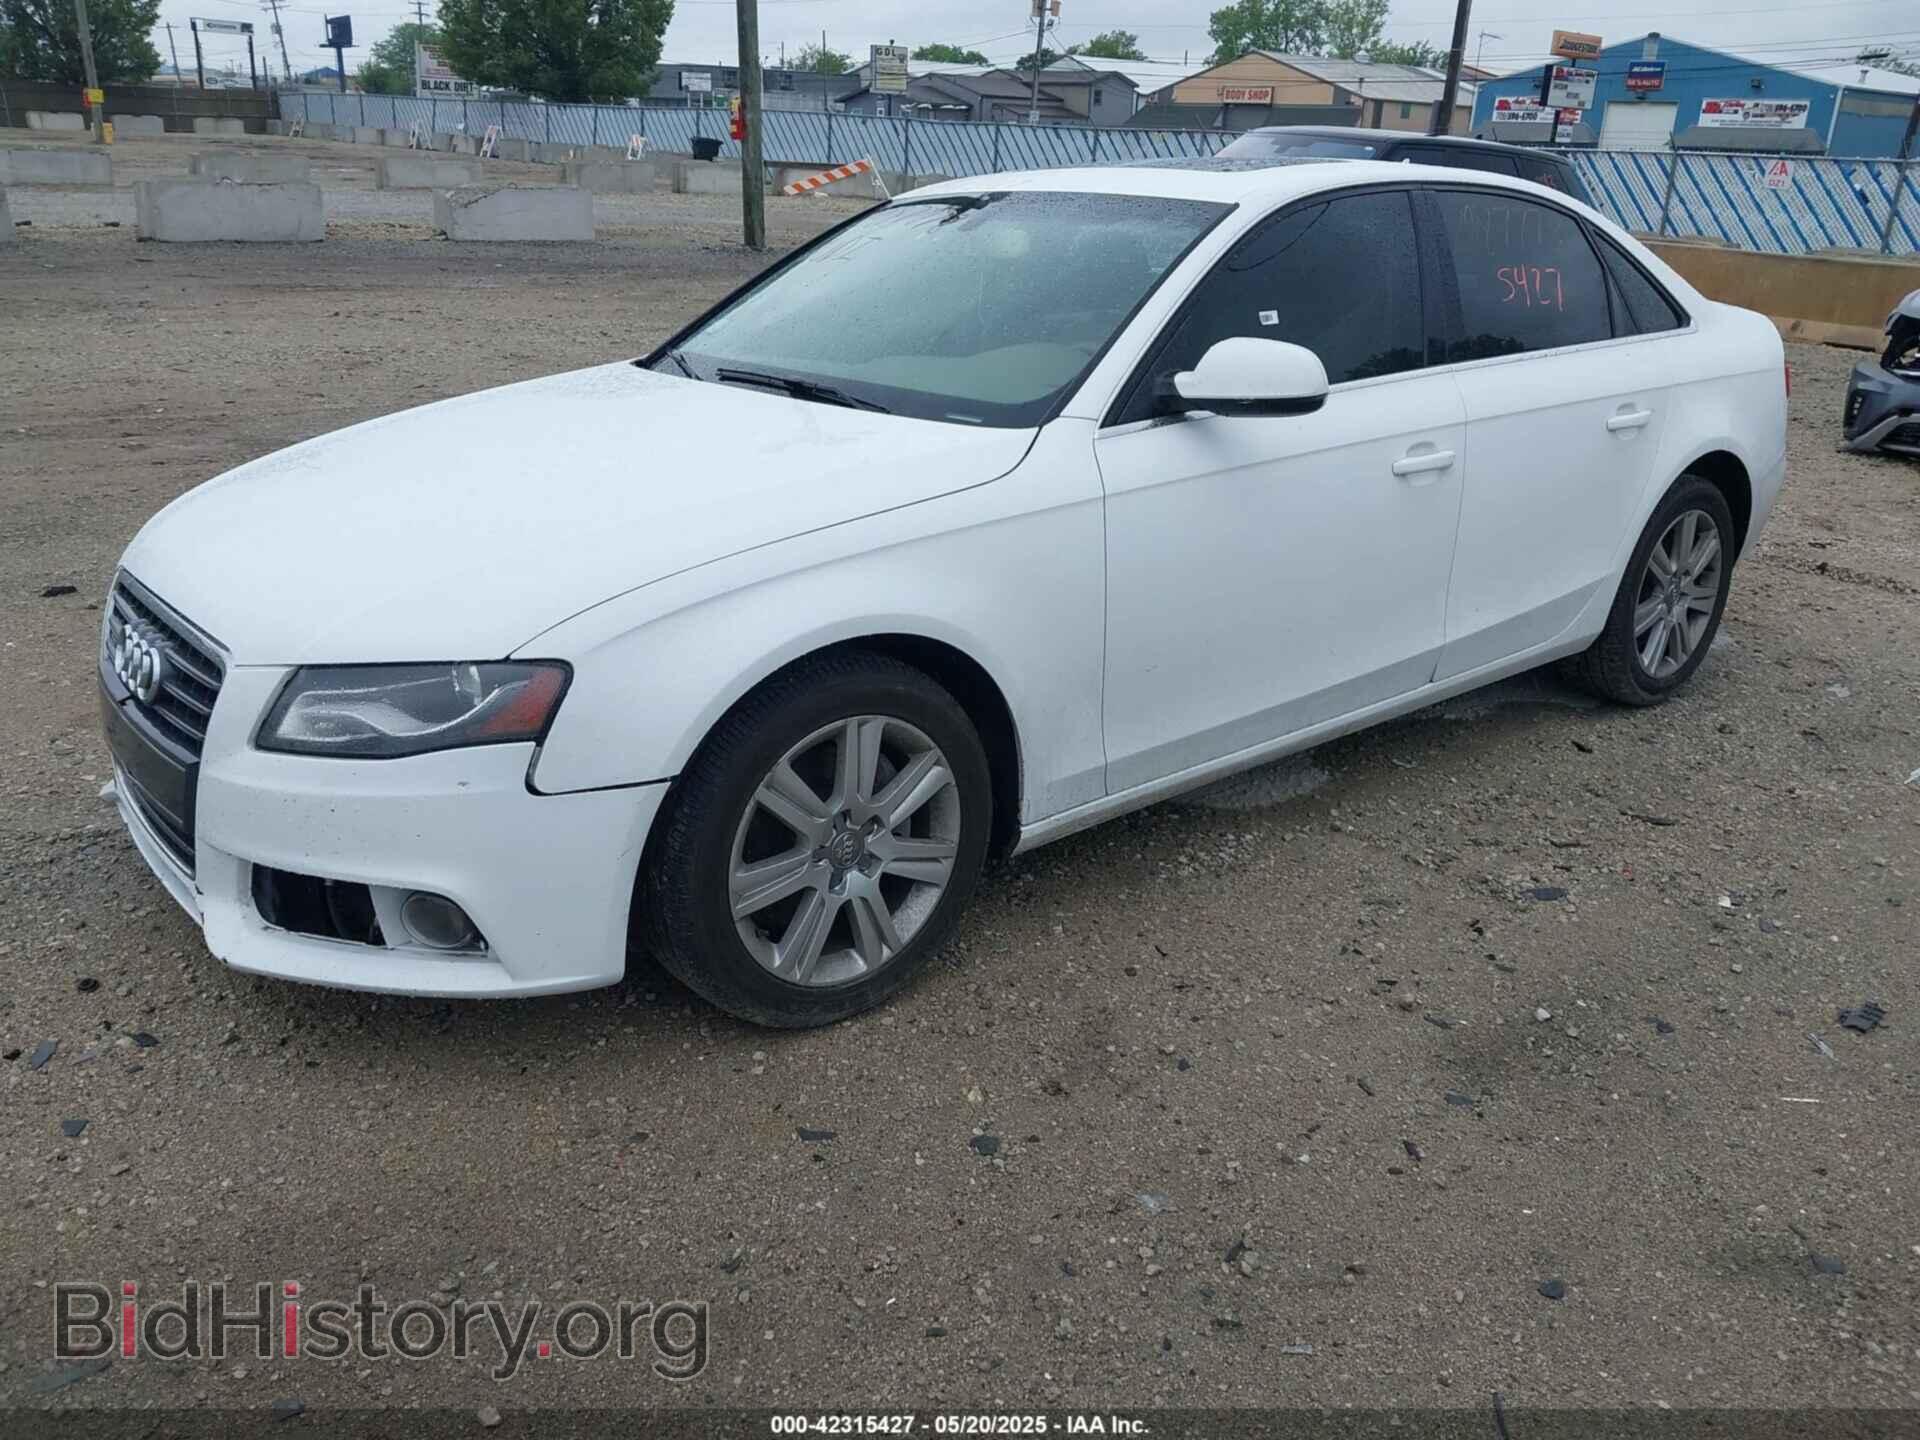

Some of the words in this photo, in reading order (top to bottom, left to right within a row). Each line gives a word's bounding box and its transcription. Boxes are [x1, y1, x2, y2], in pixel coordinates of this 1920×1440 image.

[421, 80, 452, 91] BLACK
[454, 82, 474, 92] DIRT
[1225, 90, 1246, 100] BODY
[1247, 89, 1270, 101] SHOP
